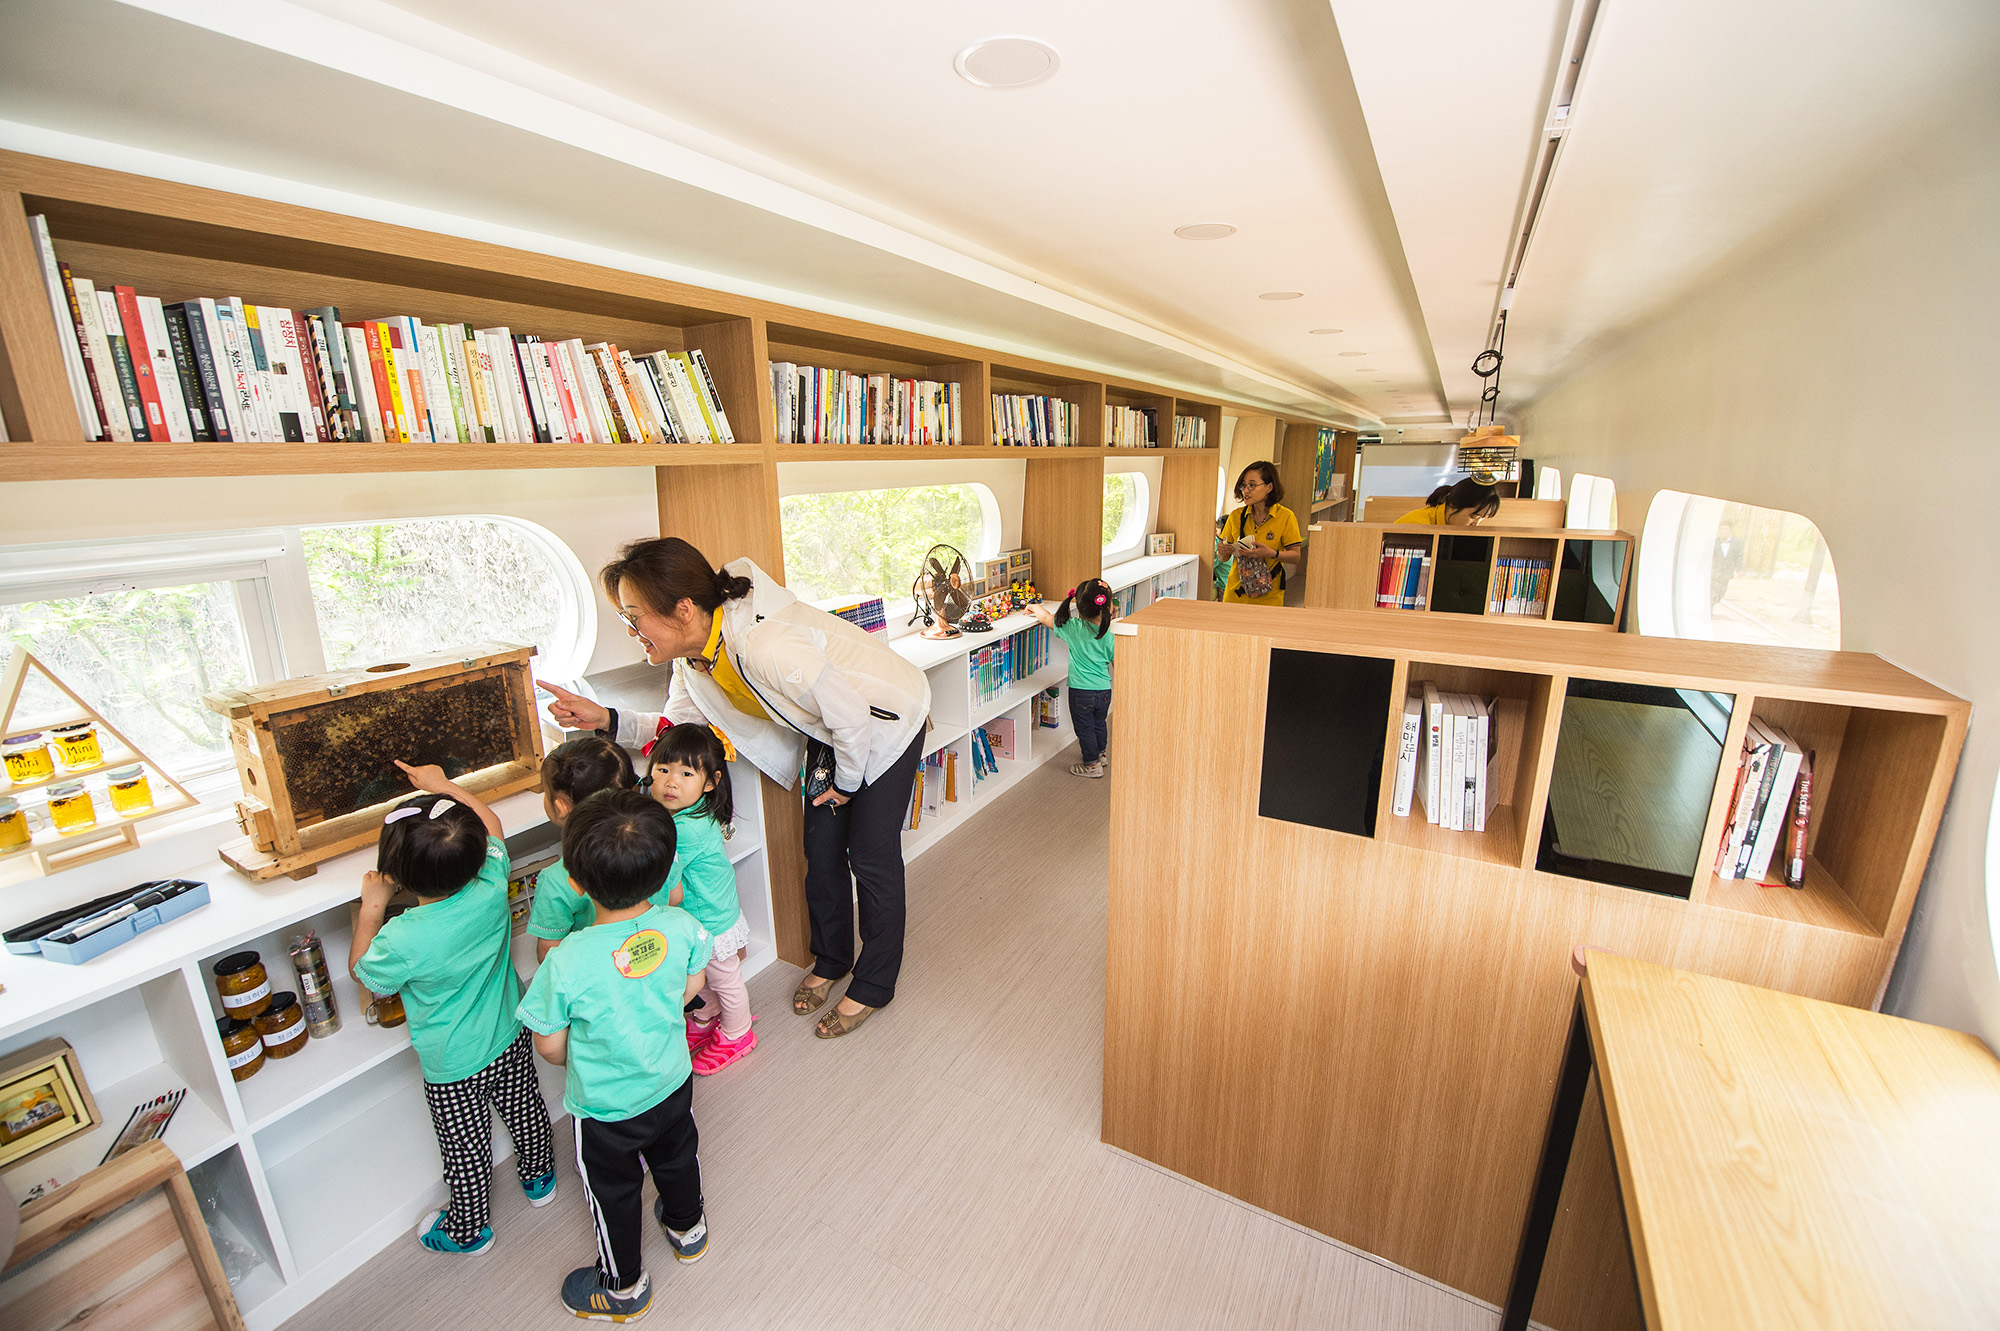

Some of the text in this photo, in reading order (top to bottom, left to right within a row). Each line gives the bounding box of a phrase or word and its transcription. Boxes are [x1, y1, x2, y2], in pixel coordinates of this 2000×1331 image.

[280, 320, 297, 348] 참정치
[66, 743, 93, 756] Mini
[11, 757, 39, 769] Mini
[1800, 779, 1809, 792] THE
[1797, 792, 1808, 815] SECRET
